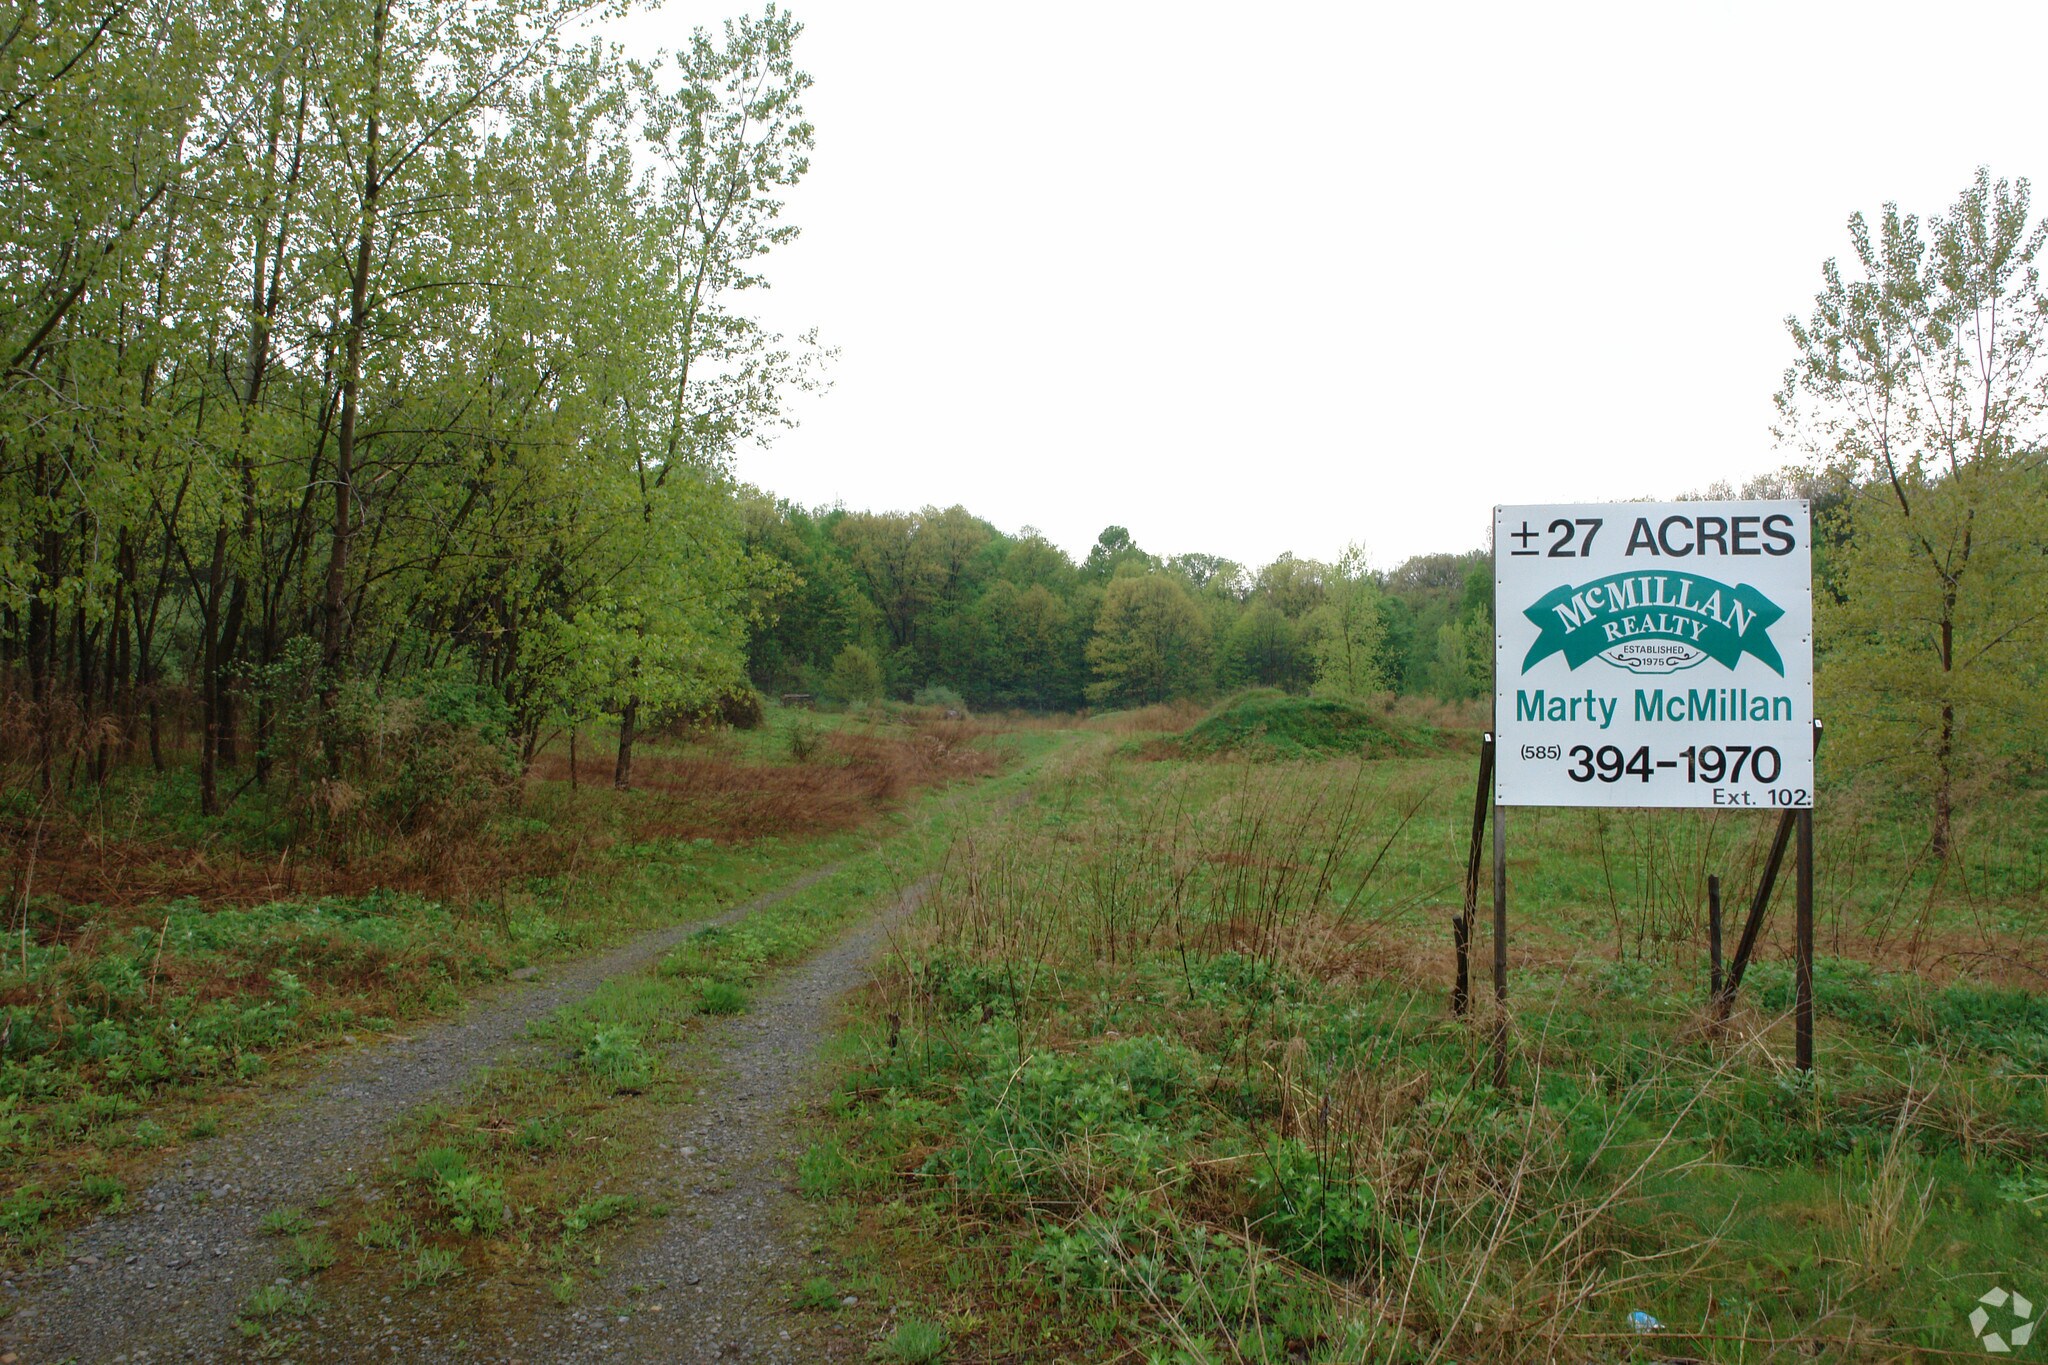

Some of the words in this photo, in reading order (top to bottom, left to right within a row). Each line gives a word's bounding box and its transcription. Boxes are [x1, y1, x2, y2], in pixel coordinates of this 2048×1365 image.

[1624, 514, 1796, 556] ACRES
[1602, 613, 1708, 642] REALTY
[1623, 645, 1685, 654] ESTABLISHED
[1642, 658, 1665, 666] 1975
[1516, 689, 1617, 729] Marty
[1634, 688, 1792, 721] McMillan
[1520, 744, 1561, 760] (585)
[1567, 745, 1781, 783] 394-1970
[1713, 788, 1756, 805] Ext.
